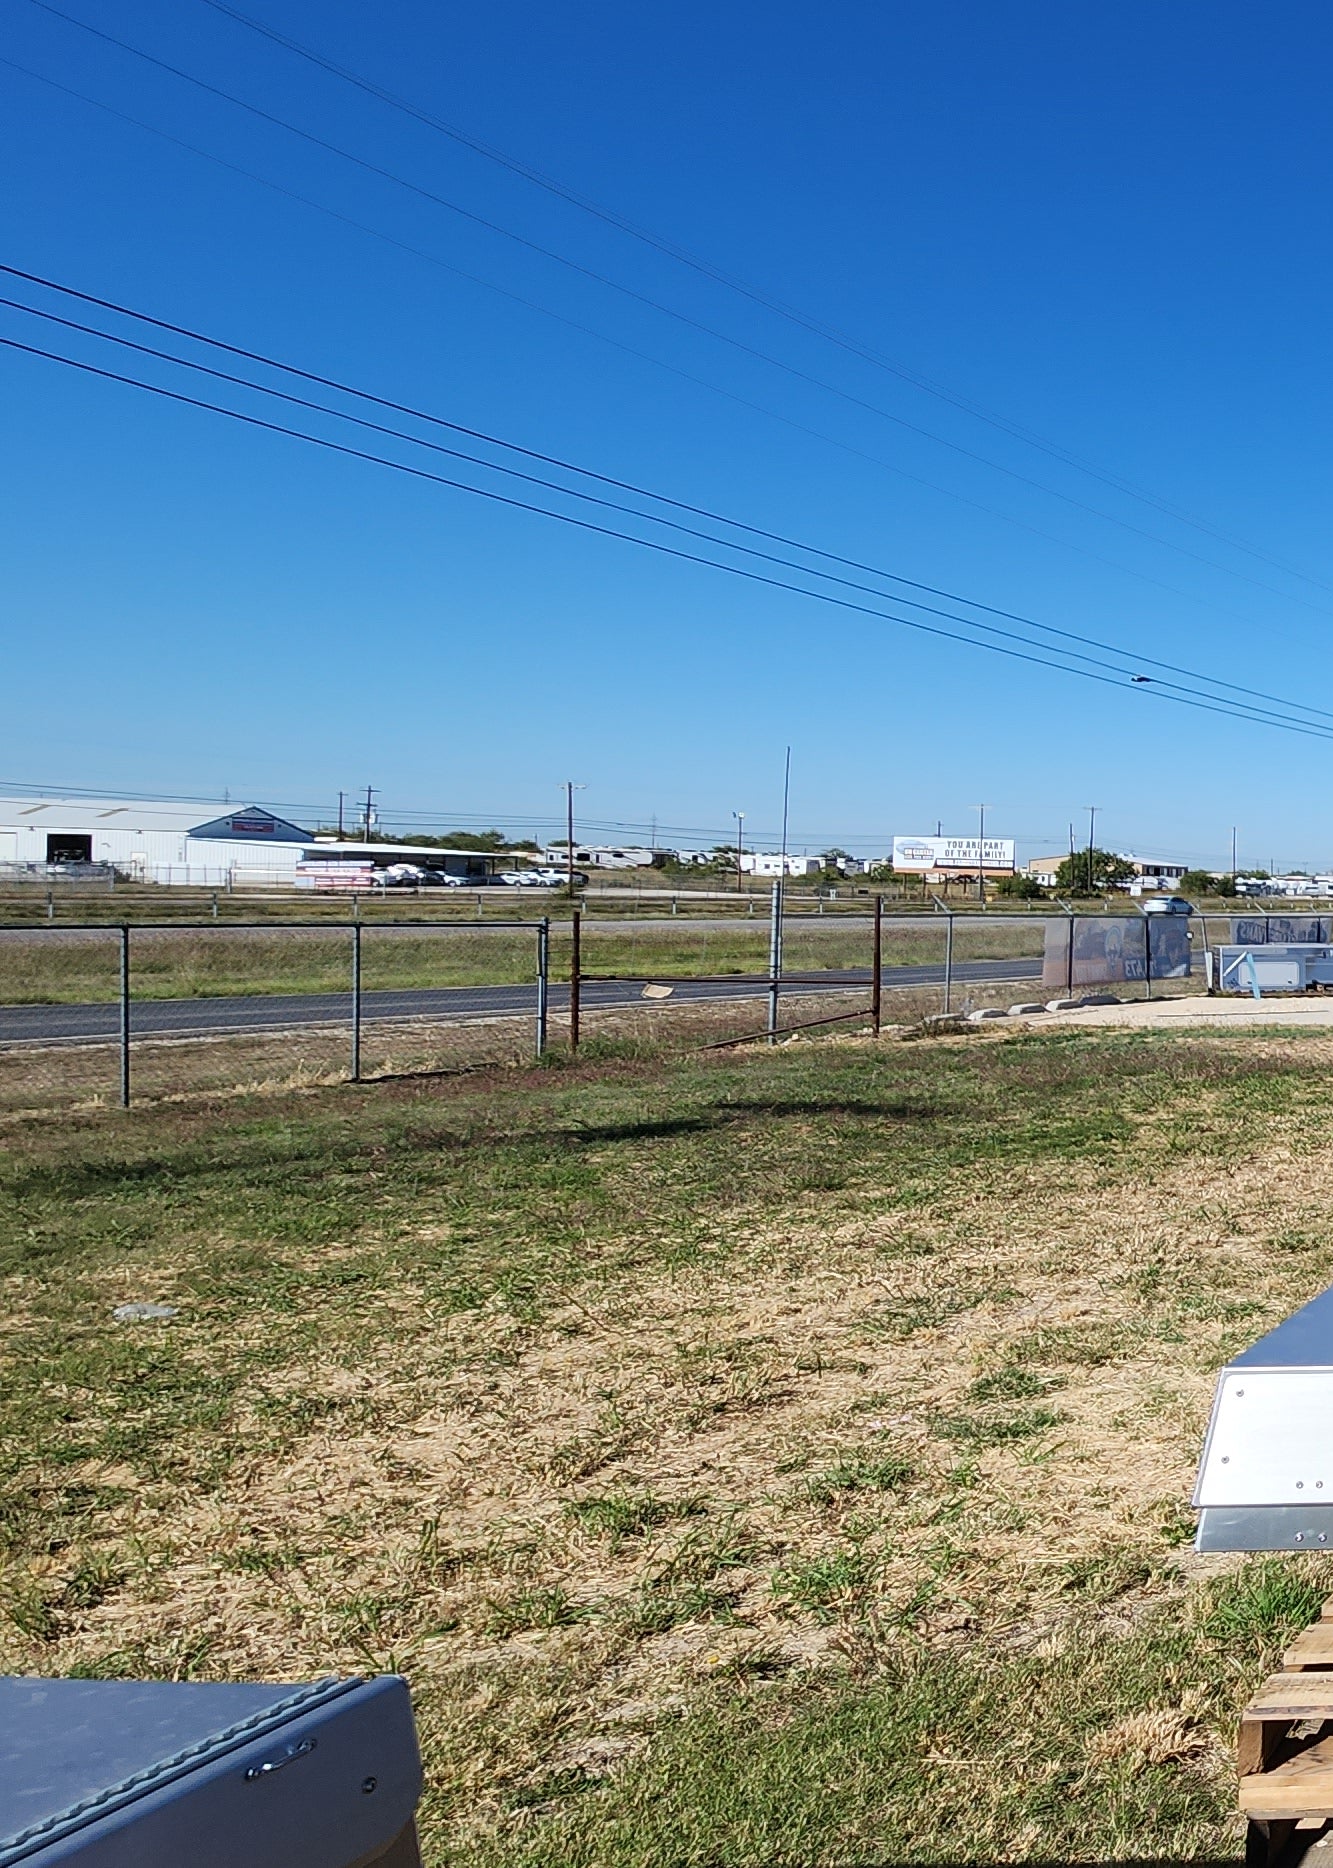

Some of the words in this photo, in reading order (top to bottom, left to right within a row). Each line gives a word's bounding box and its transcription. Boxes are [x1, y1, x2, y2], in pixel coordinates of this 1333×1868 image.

[947, 840, 963, 849] YOU
[983, 841, 1004, 850] PART
[945, 849, 955, 857] OF
[957, 850, 972, 858] THE
